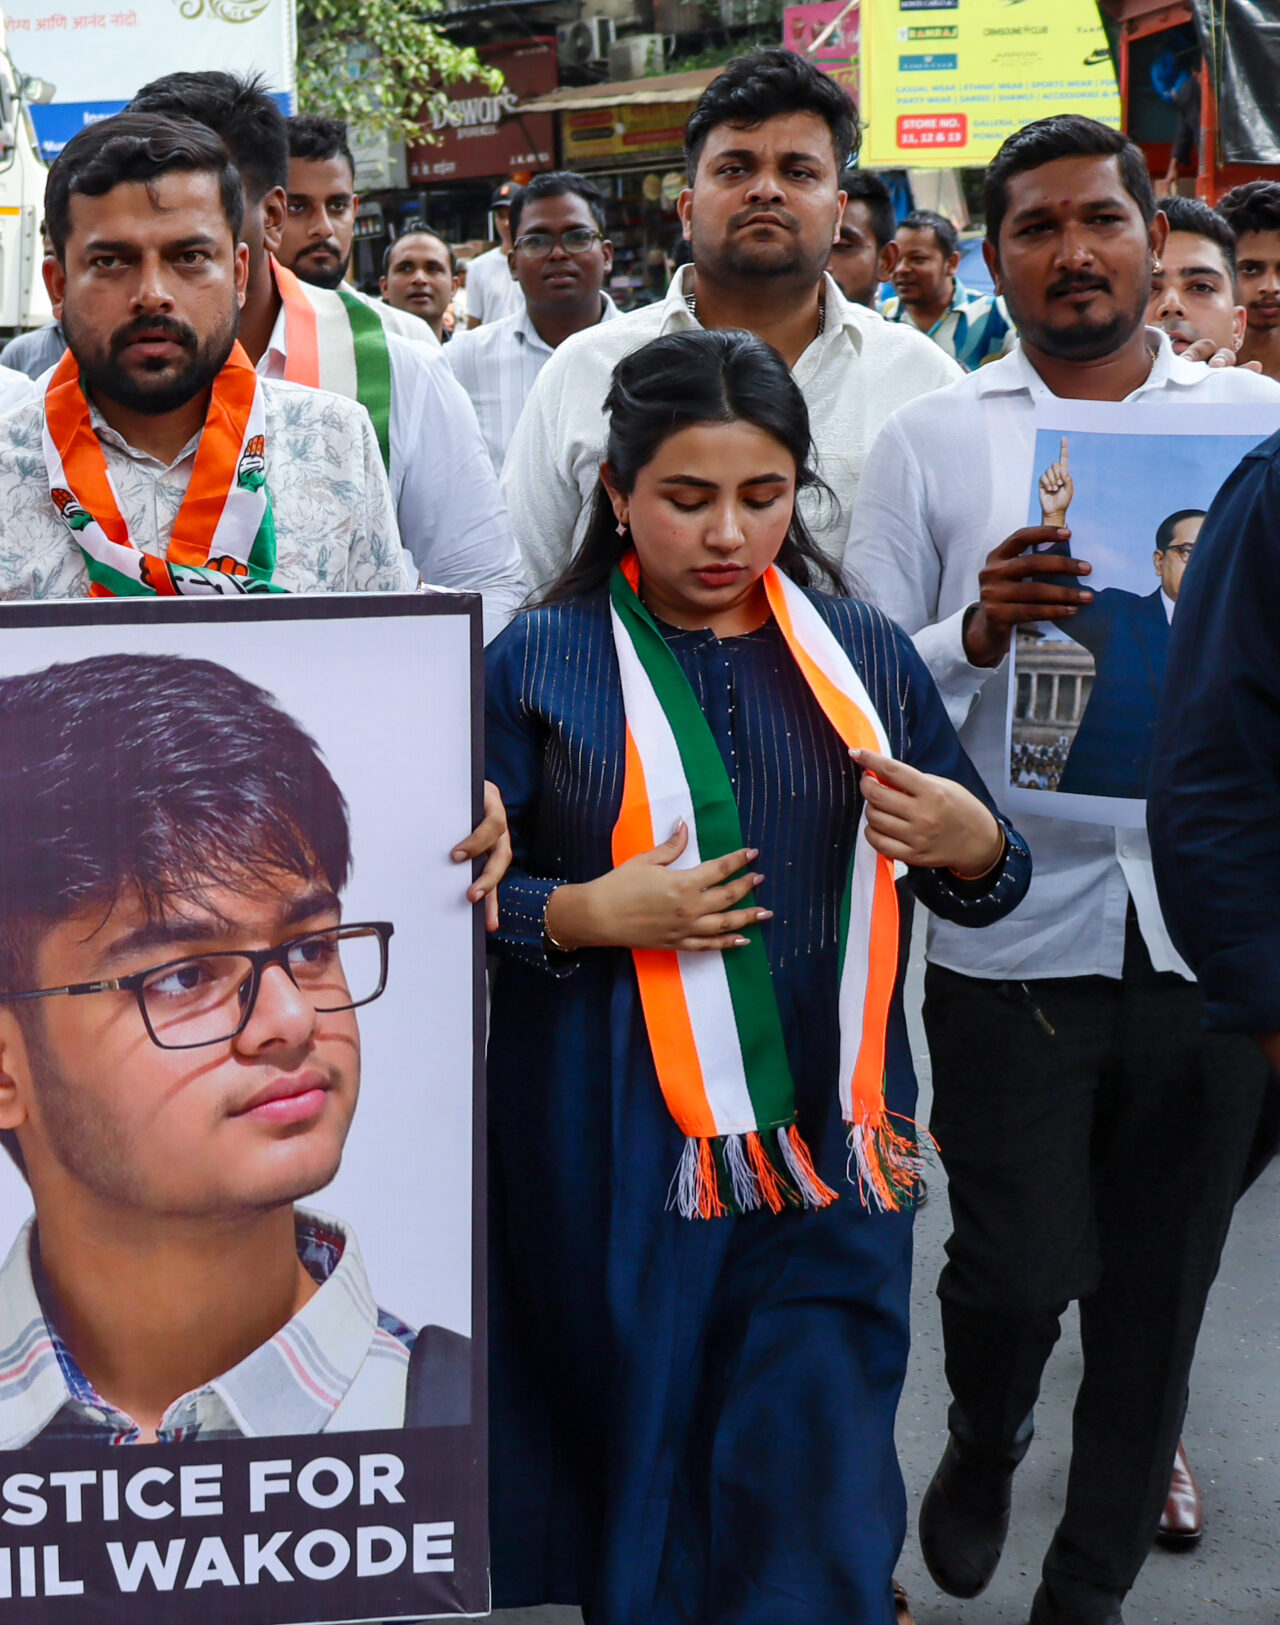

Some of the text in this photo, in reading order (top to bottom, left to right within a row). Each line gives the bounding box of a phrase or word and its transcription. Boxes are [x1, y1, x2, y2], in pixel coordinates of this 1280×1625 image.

[36, 13, 67, 32] आणि
[72, 12, 107, 30] आनंद
[909, 28, 958, 39] RAMRAJ
[902, 117, 961, 130] STORE NO.
[920, 133, 934, 143] 12
[936, 132, 946, 143] &
[249, 1453, 407, 1513] FOR
[106, 1521, 456, 1593] WAKODE
